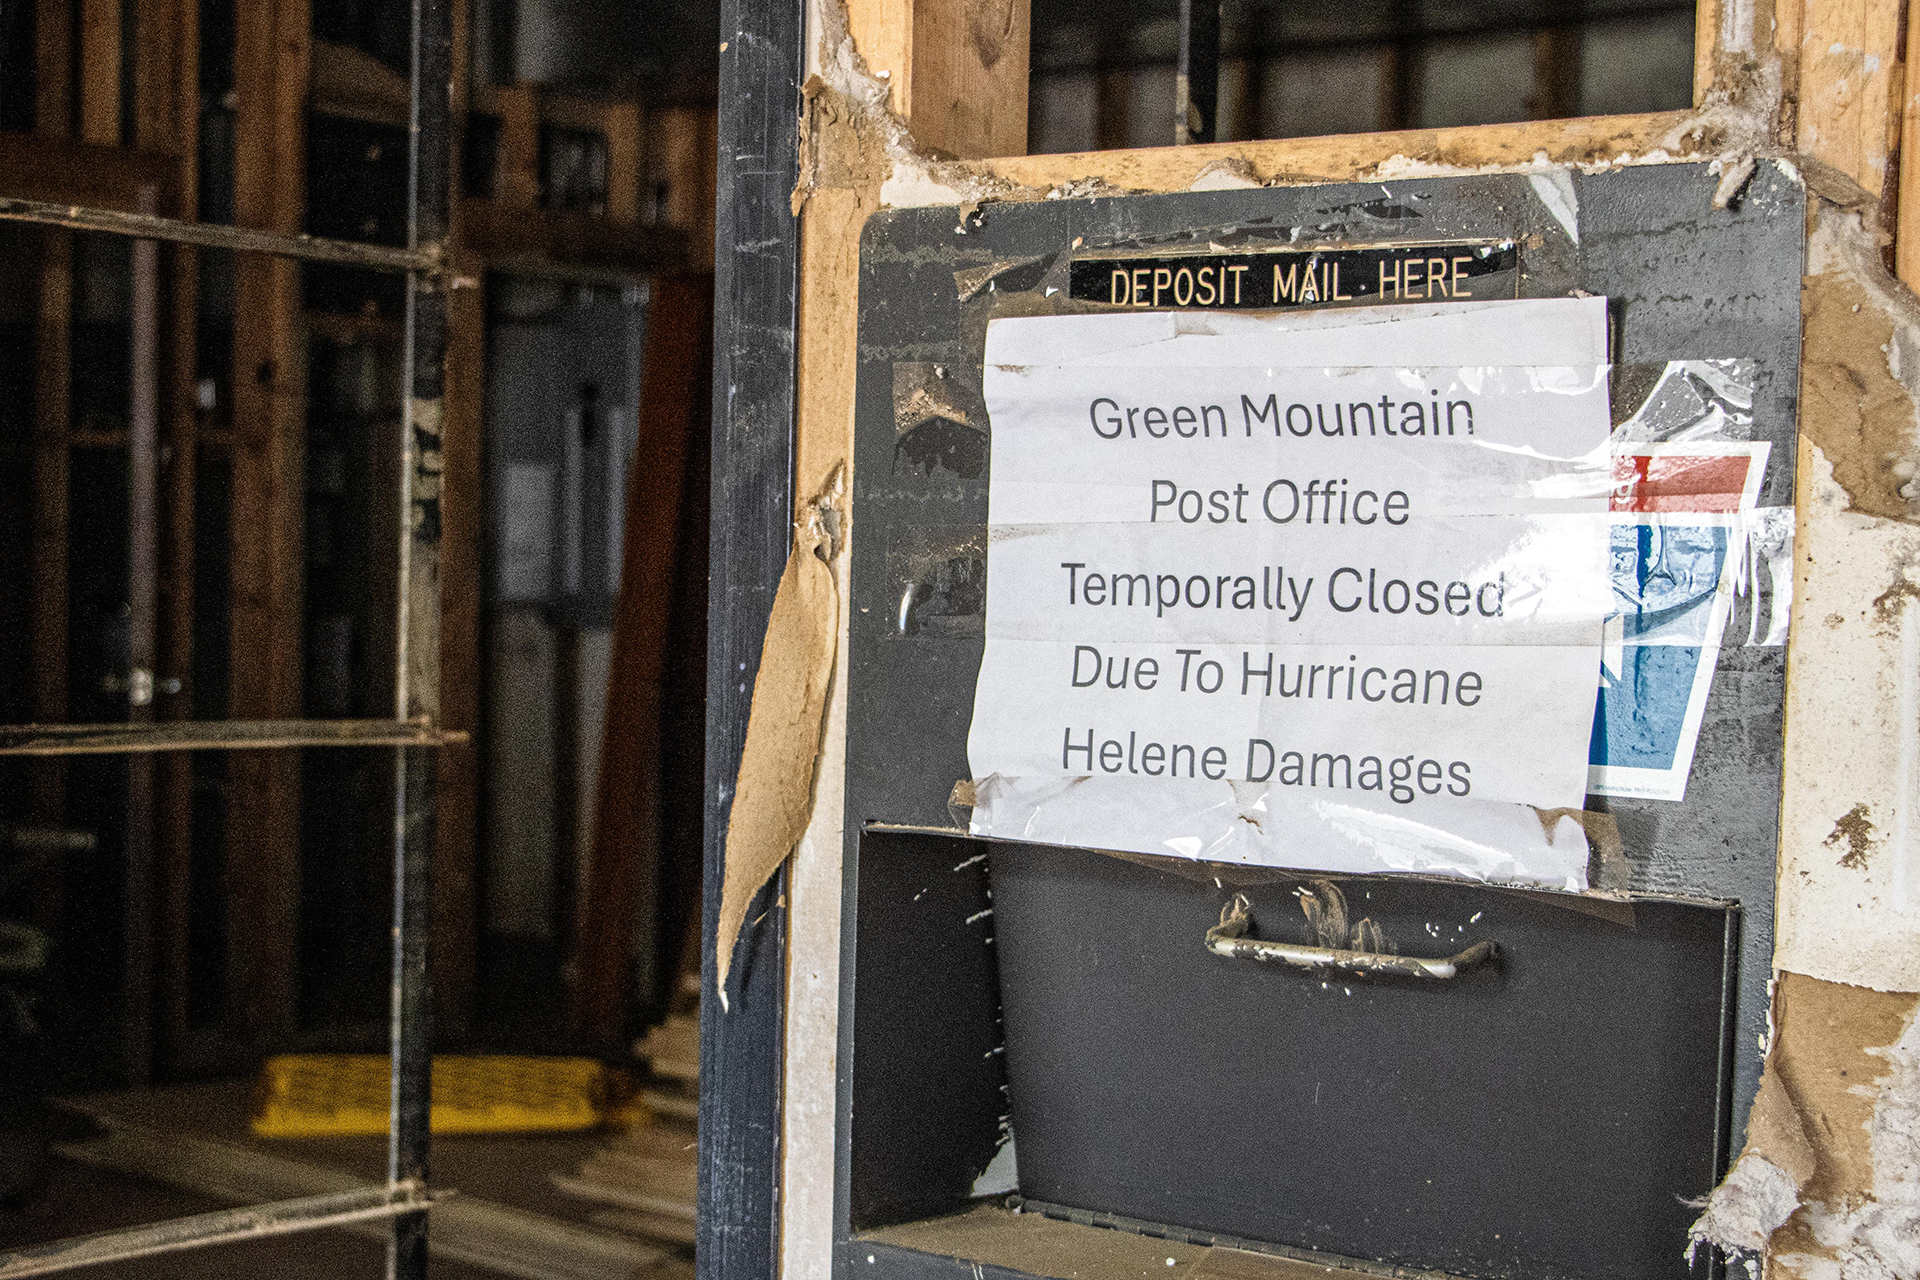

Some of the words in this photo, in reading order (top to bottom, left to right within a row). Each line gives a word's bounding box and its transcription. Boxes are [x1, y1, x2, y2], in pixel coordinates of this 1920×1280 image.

[1111, 266, 1248, 306] DEPOSIT
[1273, 263, 1352, 303] MAIL
[1379, 256, 1473, 299] HERE
[1090, 398, 1227, 439] Green
[1241, 389, 1474, 437] Mountain
[1151, 480, 1248, 524] Post
[1263, 478, 1410, 525] Office
[1061, 563, 1314, 622] Temporally
[1328, 567, 1505, 617] Closed
[1071, 645, 1159, 690] Due
[1176, 649, 1223, 693] To
[1241, 652, 1483, 706] Hurricane
[1062, 727, 1227, 780] Helene
[1246, 739, 1471, 804] Damages
